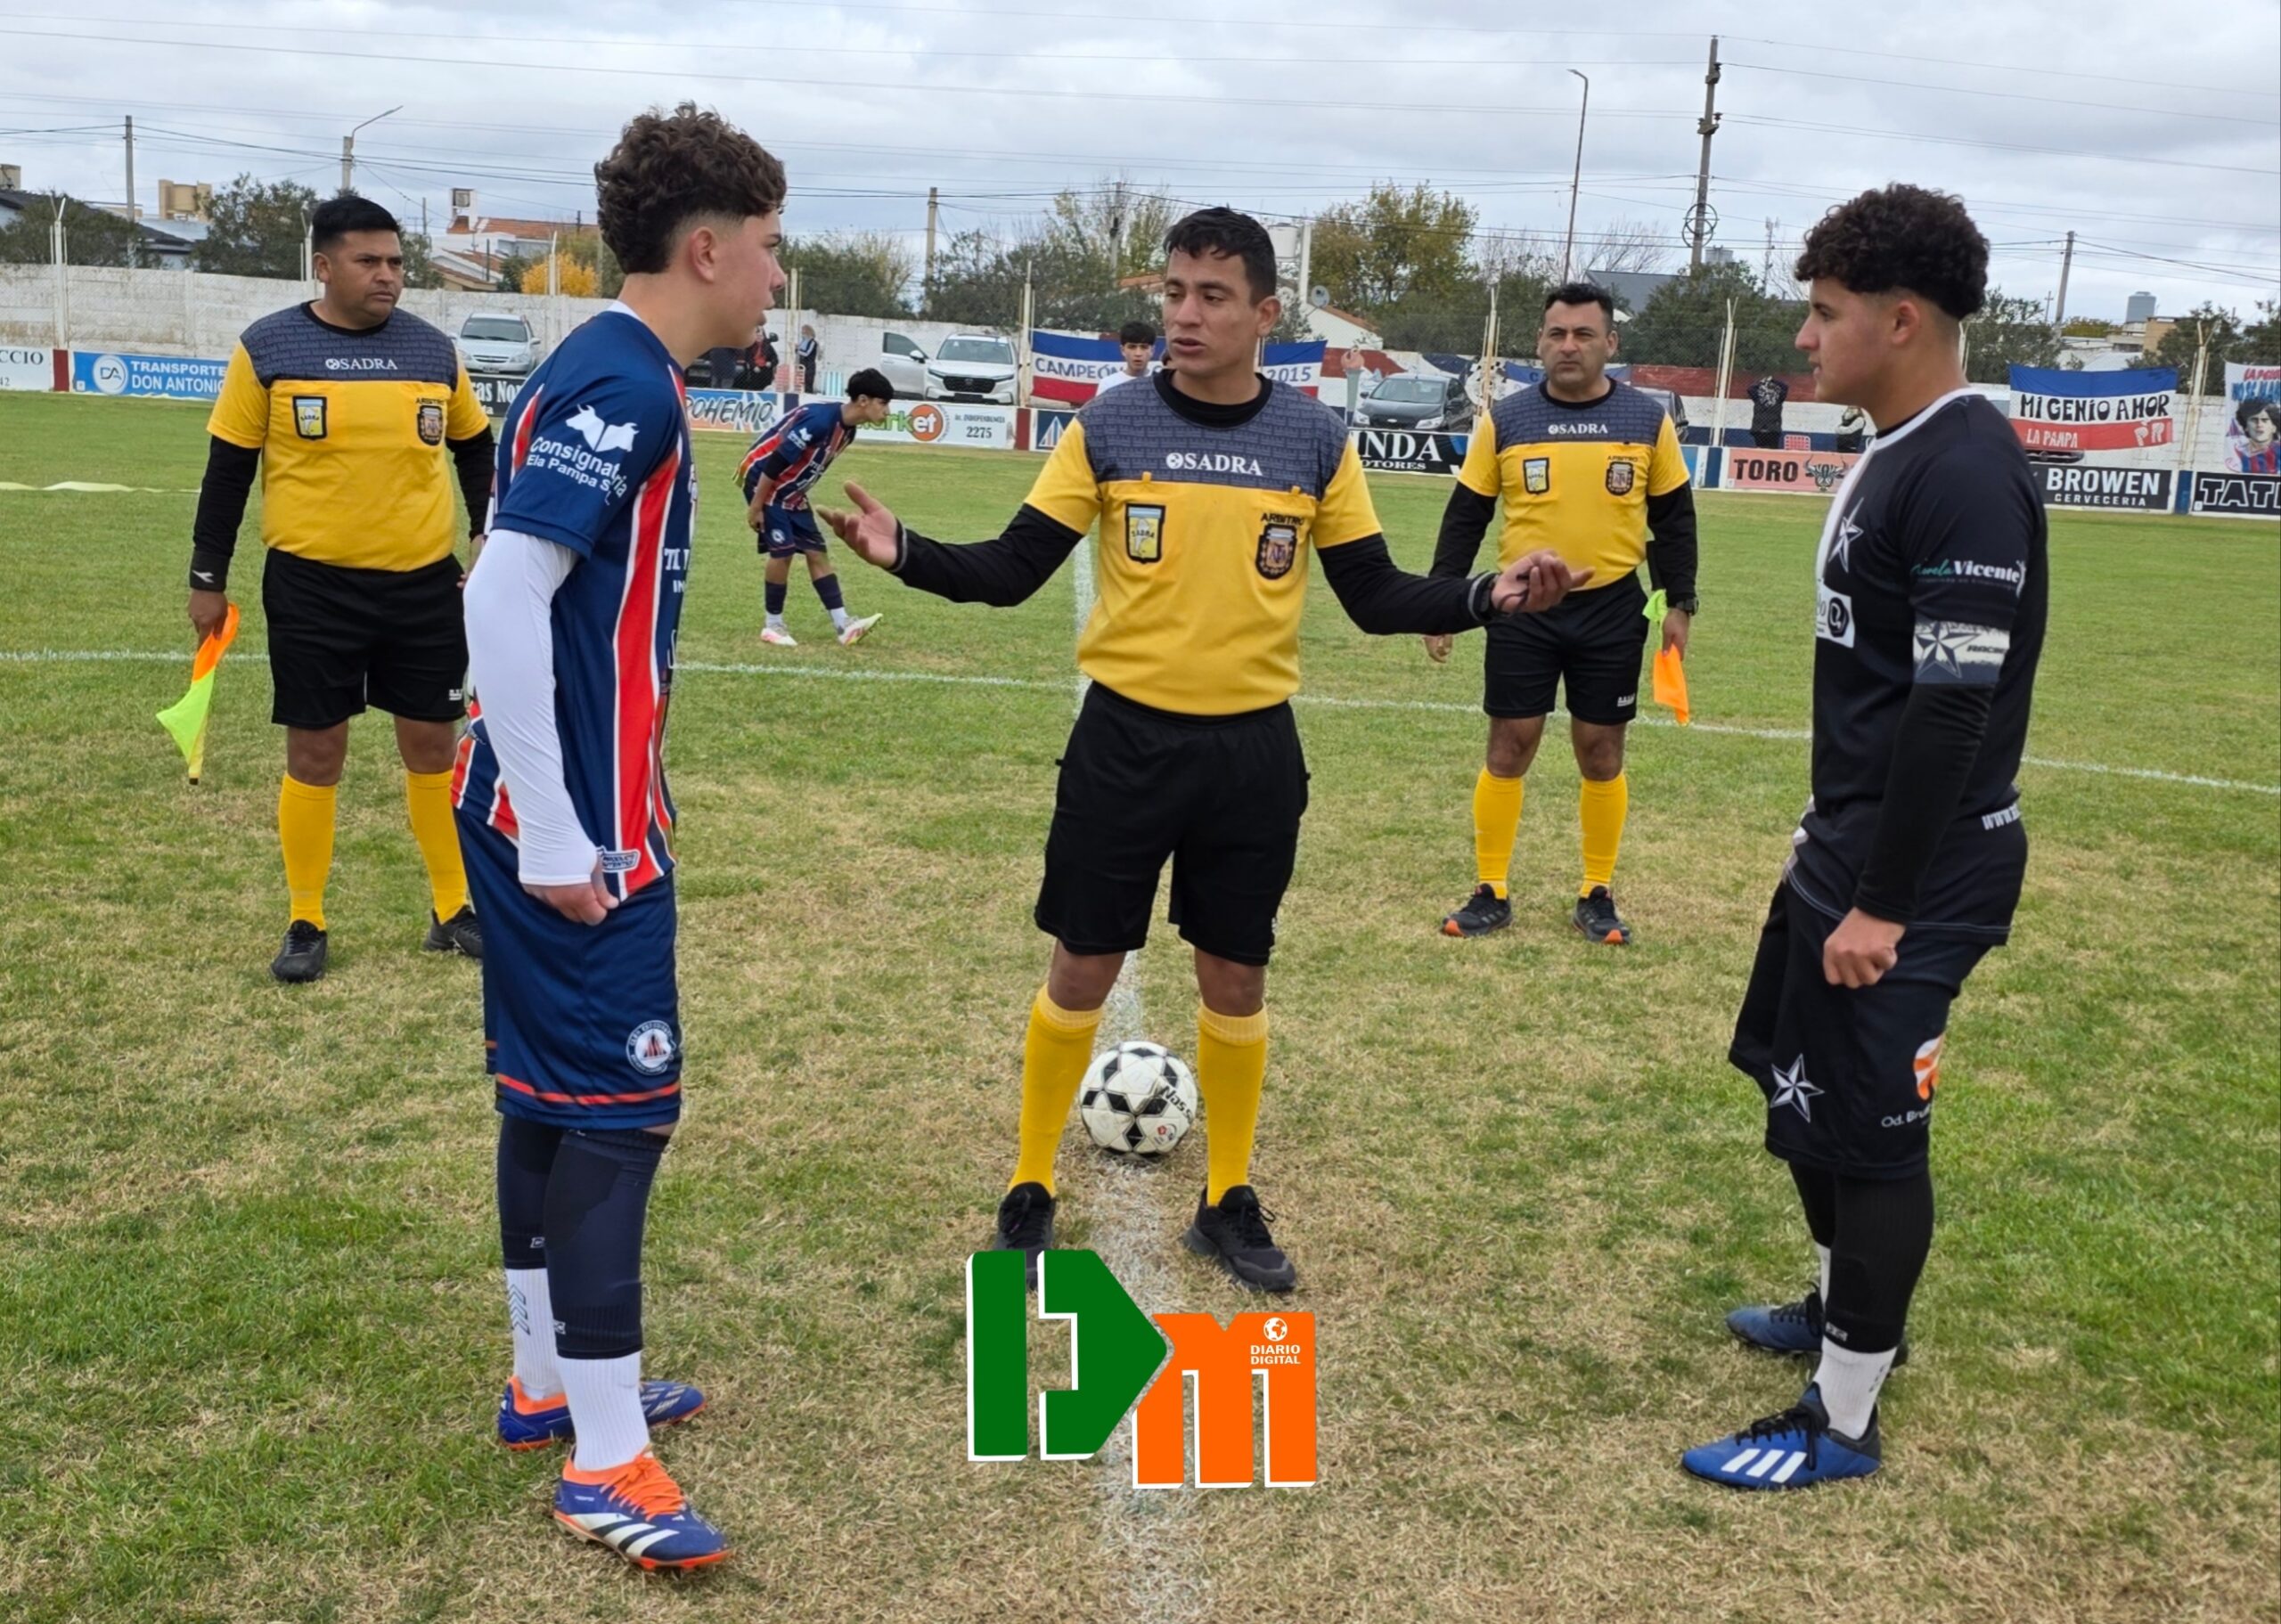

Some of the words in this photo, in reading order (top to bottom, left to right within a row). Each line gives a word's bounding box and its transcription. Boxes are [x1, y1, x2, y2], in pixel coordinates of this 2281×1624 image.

[131, 360, 226, 376] TRANSPORTE
[340, 357, 398, 371] SADRA
[132, 374, 164, 390] DON
[1267, 366, 1312, 383] 2015
[966, 426, 993, 438] 2275
[1559, 423, 1608, 435] SADRA
[2026, 428, 2040, 445] LA
[2042, 430, 2079, 449] PAMPA
[547, 457, 599, 487] Pampa
[1184, 452, 1263, 476] SADRA
[1360, 459, 1427, 470] OTORES
[1734, 459, 1798, 482] TORO
[2046, 468, 2161, 496] BROWEN
[2054, 493, 2146, 507] CERVECERIA
[1260, 512, 1304, 526] ARBITRO
[1953, 559, 2021, 583] Vicente
